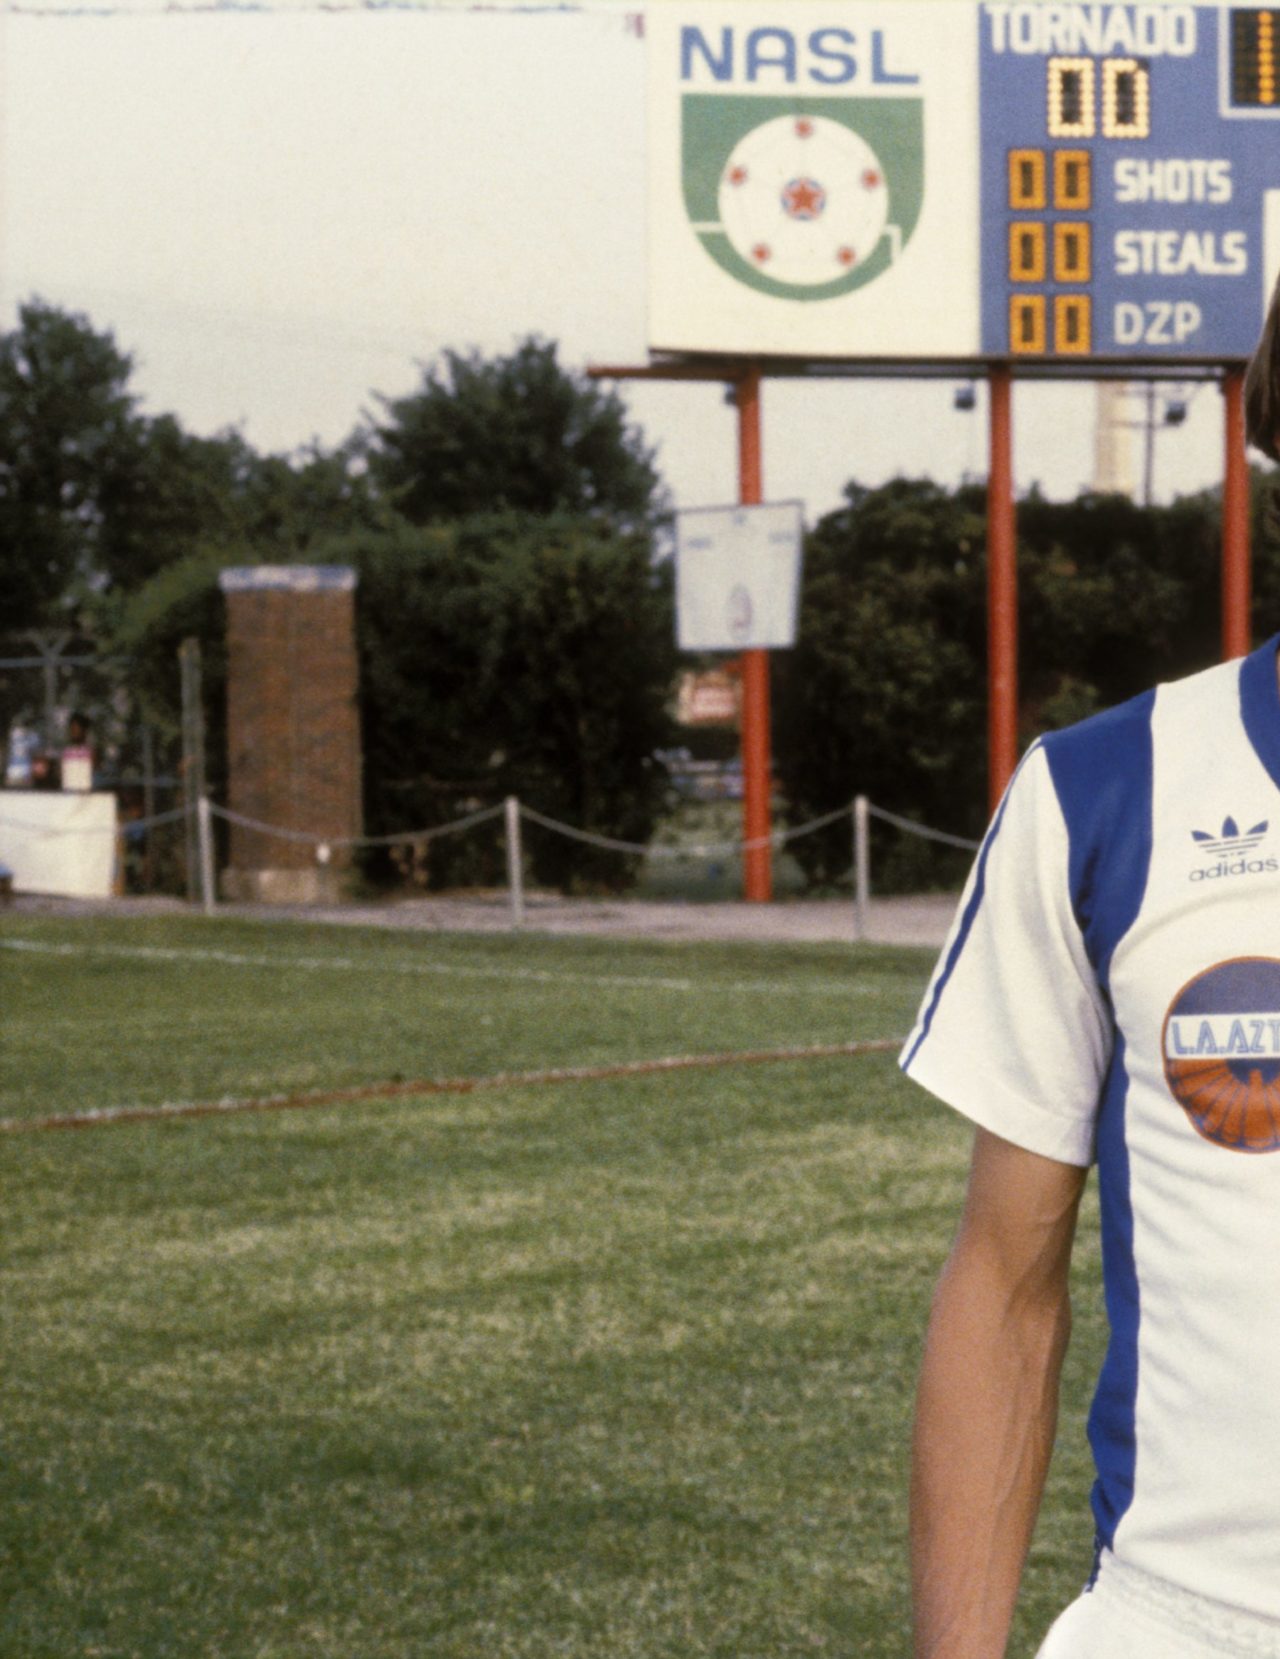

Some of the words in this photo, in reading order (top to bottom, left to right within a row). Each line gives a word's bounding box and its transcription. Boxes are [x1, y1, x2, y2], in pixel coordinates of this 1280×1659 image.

[680, 25, 920, 84] NASL
[984, 5, 1197, 57] TORNADO
[1047, 57, 1149, 138] 00
[1007, 149, 1092, 210] 00
[1113, 158, 1232, 203] SHOTS
[1007, 221, 1092, 283] 00
[1113, 230, 1248, 275] STEALS
[1008, 294, 1092, 355] 00
[1113, 302, 1202, 345] DZP
[1189, 857, 1279, 882] adidas
